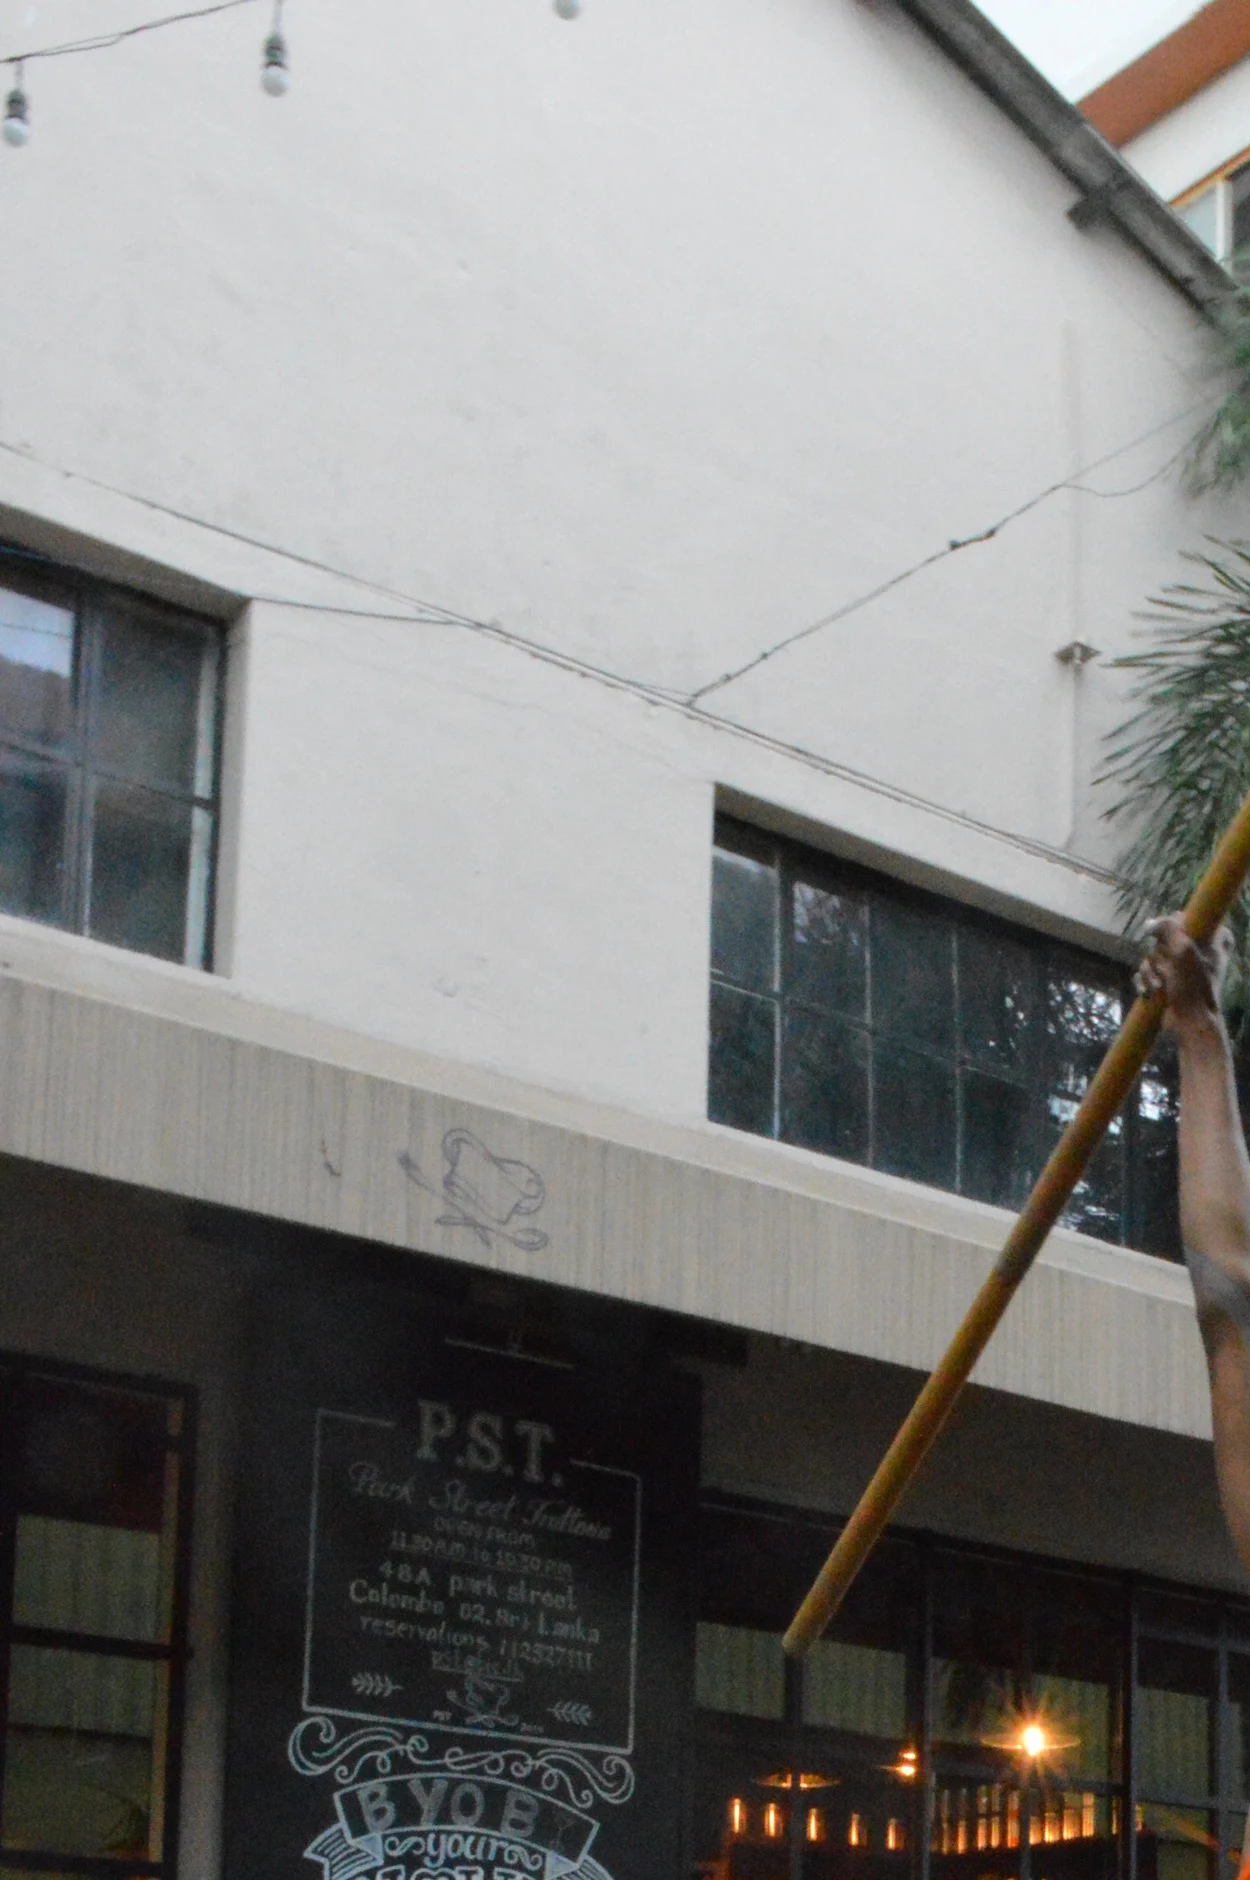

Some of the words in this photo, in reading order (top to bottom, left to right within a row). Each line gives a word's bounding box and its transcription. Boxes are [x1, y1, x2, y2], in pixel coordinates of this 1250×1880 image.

[417, 1398, 565, 1488] P.S.T.
[349, 1460, 416, 1505] Park
[349, 1578, 446, 1616] Colombo
[537, 1611, 601, 1645] Lanka
[356, 1777, 540, 1839] BYOB
[424, 1832, 512, 1869] your
